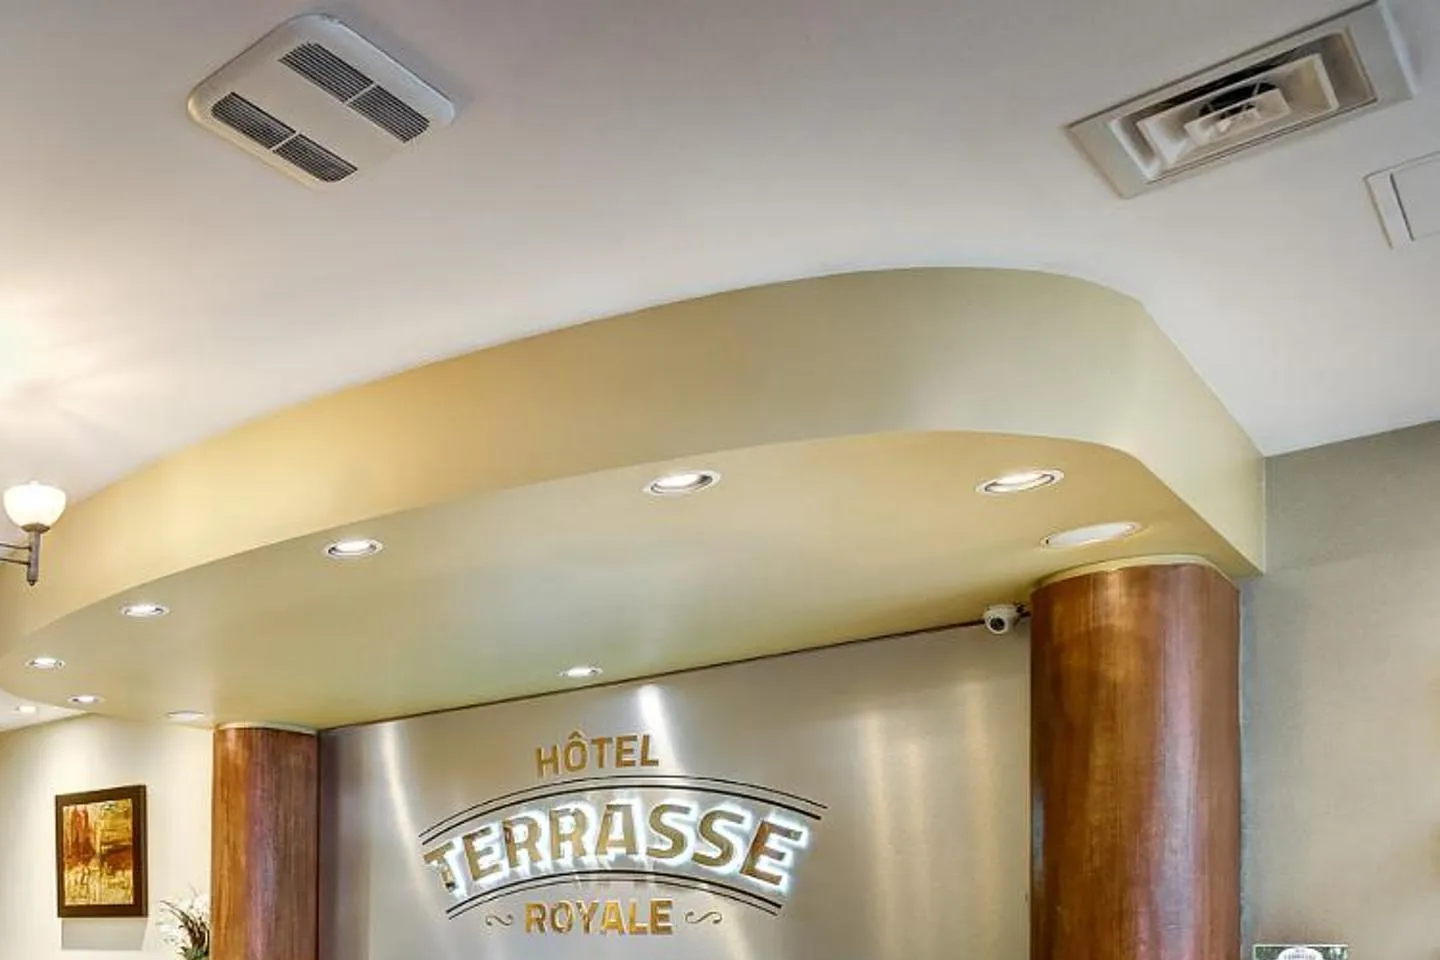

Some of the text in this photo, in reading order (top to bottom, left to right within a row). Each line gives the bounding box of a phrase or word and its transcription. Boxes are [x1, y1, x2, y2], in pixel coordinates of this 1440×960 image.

[536, 730, 659, 777] HÔTEL
[423, 801, 804, 892] TERRASSE
[525, 900, 674, 935] ROYALE
